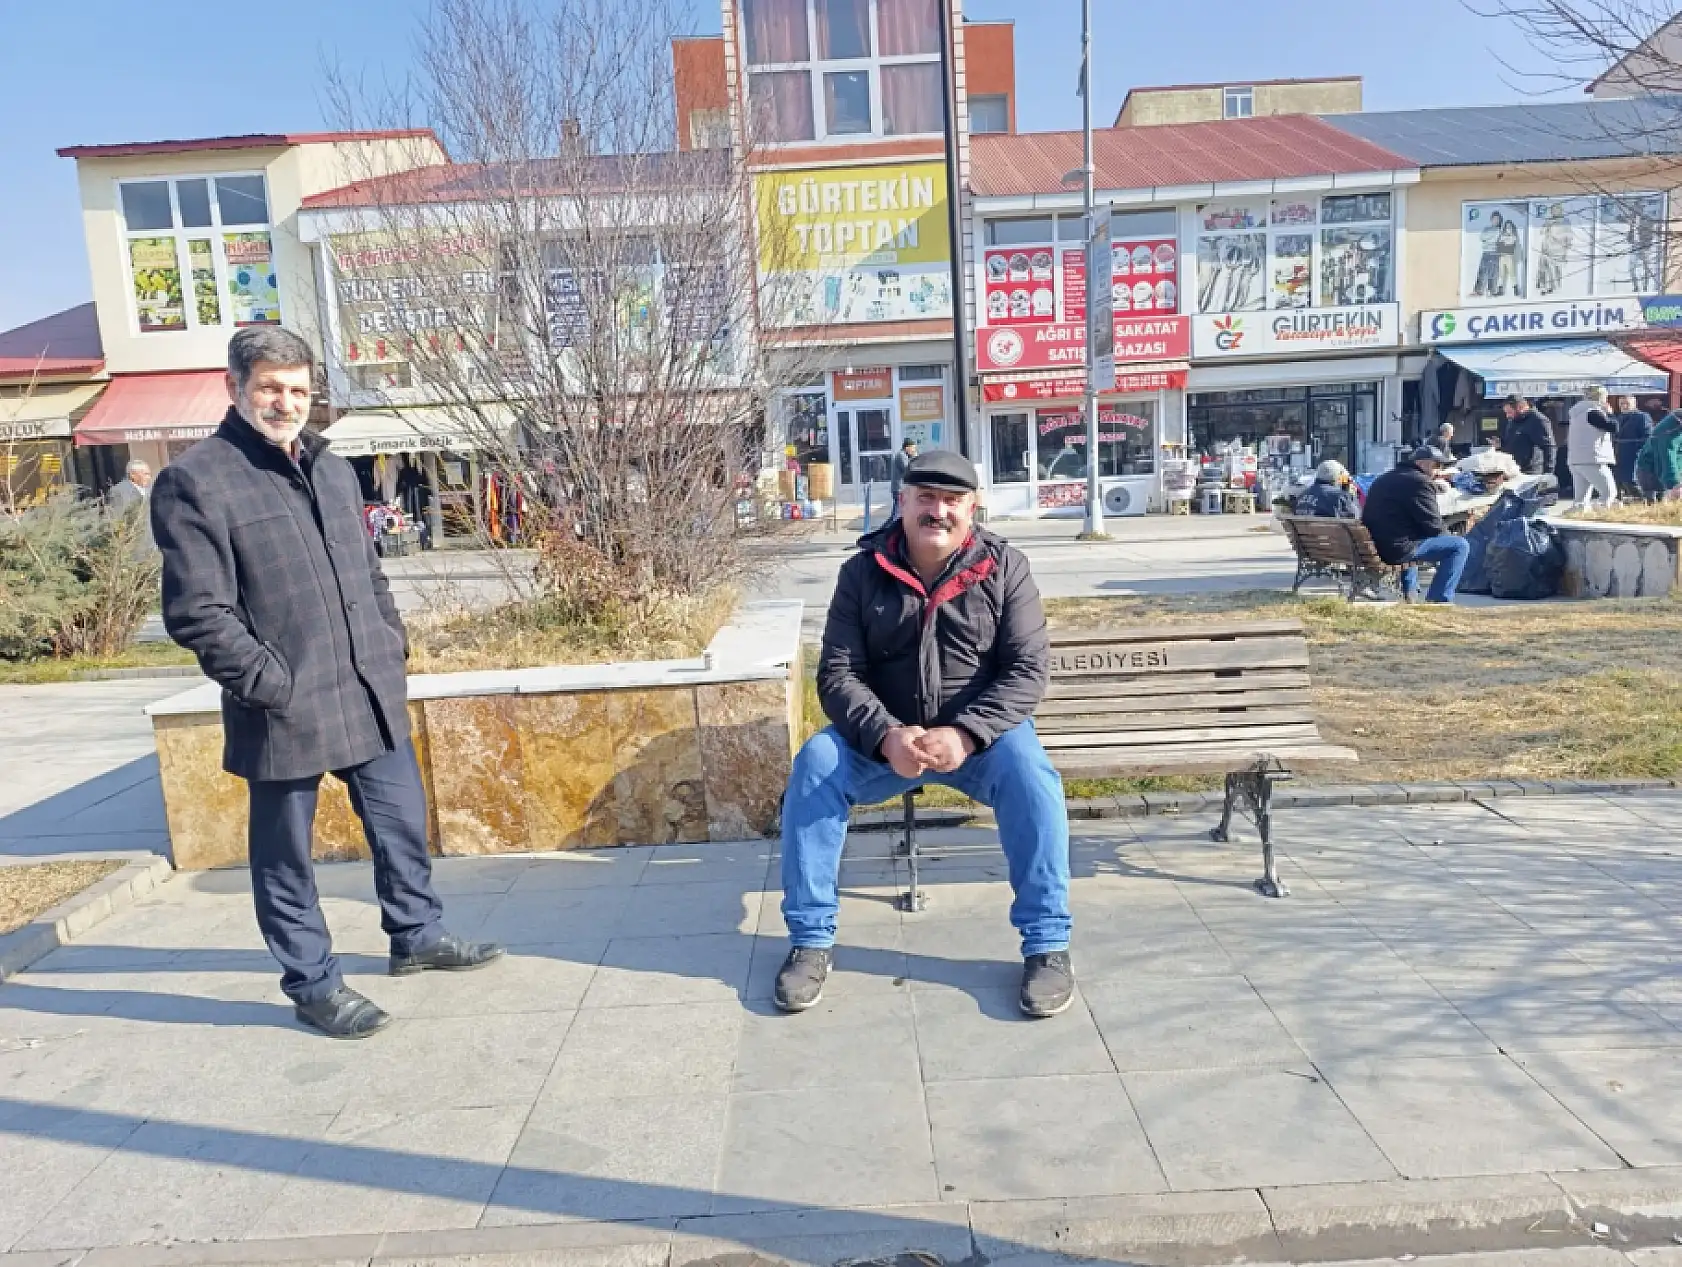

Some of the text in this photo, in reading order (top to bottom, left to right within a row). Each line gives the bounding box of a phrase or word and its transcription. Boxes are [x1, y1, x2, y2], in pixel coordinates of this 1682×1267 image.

[779, 172, 933, 216] GÜRTEKİN
[795, 218, 919, 253] TOPTAN
[1035, 326, 1071, 343] AĞRI
[1115, 320, 1180, 338] SAKATAT
[1272, 307, 1382, 335] GÜRTEKİN
[1467, 311, 1544, 338] ÇAKIR
[1551, 302, 1624, 332] GİYİM
[1114, 341, 1168, 357] ĞAZASI
[369, 436, 417, 454] Şımarık
[1050, 648, 1168, 671] ELEDİYESİ
